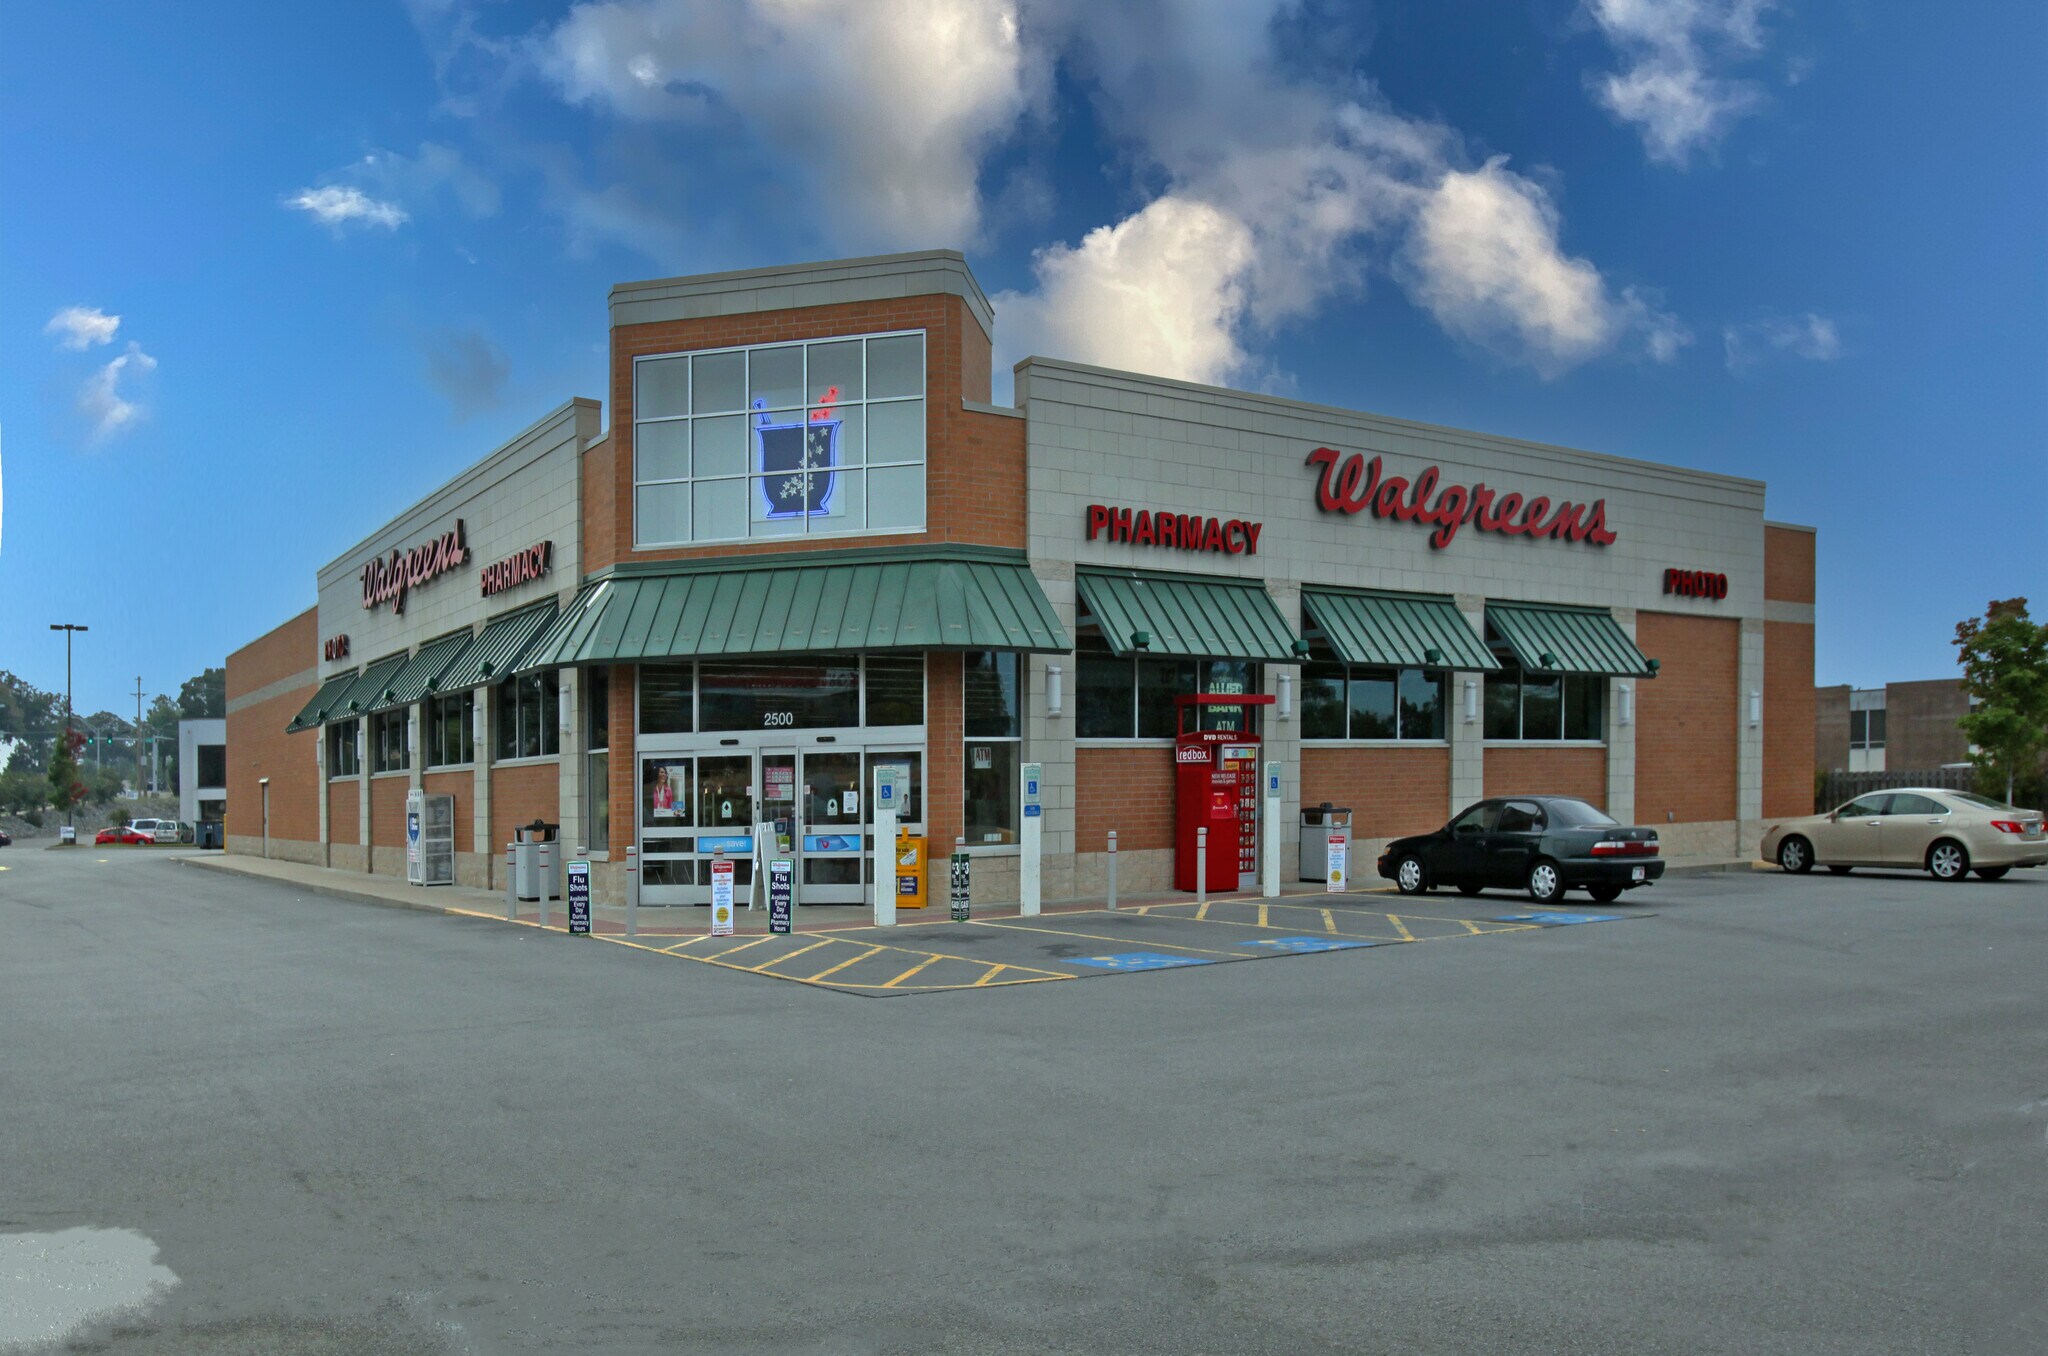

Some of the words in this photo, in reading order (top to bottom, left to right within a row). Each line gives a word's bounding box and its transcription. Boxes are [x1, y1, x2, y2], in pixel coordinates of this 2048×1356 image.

[1305, 447, 1617, 549] Walgreens
[1086, 504, 1263, 555] PHARMACY
[360, 518, 470, 615] Walgreens
[481, 540, 552, 598] PHARMACY
[1663, 568, 1728, 600] PHOTO
[1208, 682, 1243, 695] ALLIED
[764, 712, 794, 726] 2500
[1216, 720, 1235, 731] ATM
[976, 748, 991, 761] ATM
[1179, 749, 1207, 760] redbox
[573, 875, 585, 883] Flu
[775, 873, 787, 881] Flu
[569, 884, 588, 892] Shots
[771, 882, 790, 890] Shots
